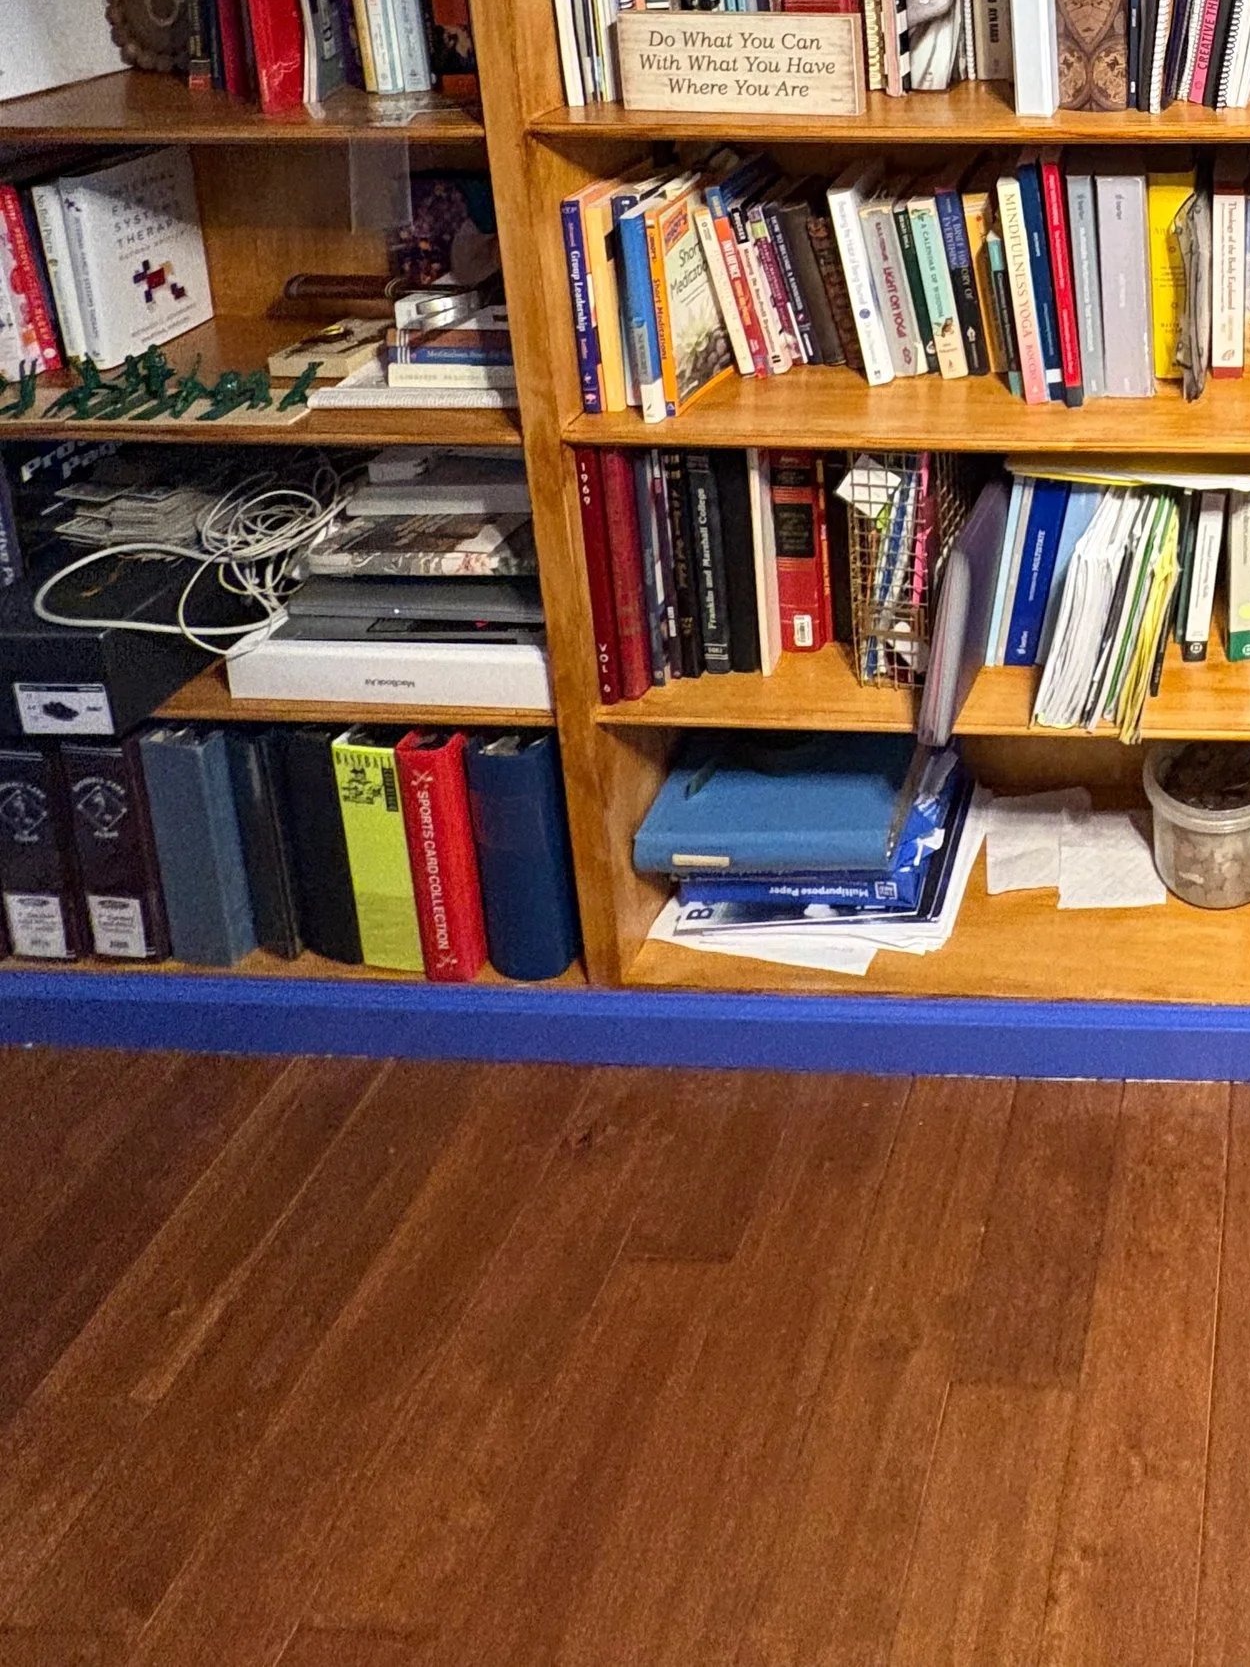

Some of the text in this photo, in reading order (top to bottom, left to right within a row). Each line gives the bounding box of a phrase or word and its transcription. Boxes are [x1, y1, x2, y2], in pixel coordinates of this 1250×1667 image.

[648, 30, 822, 50] Do What You Can
[988, 7, 999, 43] AYN RAND
[1197, 18, 1218, 70] CREATIVE
[639, 54, 836, 74] With What You Have
[668, 78, 809, 97] Where You Are
[36, 194, 45, 208] No
[43, 229, 54, 254] Parts
[733, 212, 745, 241] DRUCKER
[770, 215, 780, 232] HOW
[1227, 202, 1237, 234] Theology
[775, 233, 782, 243] TO
[922, 231, 936, 271] CALENDAR
[942, 216, 958, 269] EVERYTHING
[1228, 235, 1236, 243] of
[1228, 244, 1236, 255] the
[722, 240, 740, 280] INFLUENCE
[743, 248, 756, 276] Managing
[778, 244, 792, 271] BECOME
[951, 214, 974, 301] A BRIEF HISTORY OF
[1004, 194, 1026, 297] MINDFULNESS
[1018, 300, 1032, 338] YOGA
[1227, 256, 1237, 275] Body
[570, 250, 587, 332] Group Leadership
[653, 278, 663, 305] Short
[790, 277, 802, 311] RAINMAKER
[930, 274, 938, 283] OF
[1227, 276, 1237, 310] Explained
[883, 266, 906, 339] LIGHT ON YOGA
[932, 286, 944, 318] WISDOM
[1024, 344, 1037, 381] BOCCIO
[580, 462, 591, 505] 1969
[696, 488, 718, 630] Franklin and Marshall College
[599, 643, 609, 674] VOL
[379, 679, 416, 689] MacBook
[416, 790, 450, 951] SPORTS CARD COLLECTION
[768, 885, 868, 898] Multipurpose Paper
